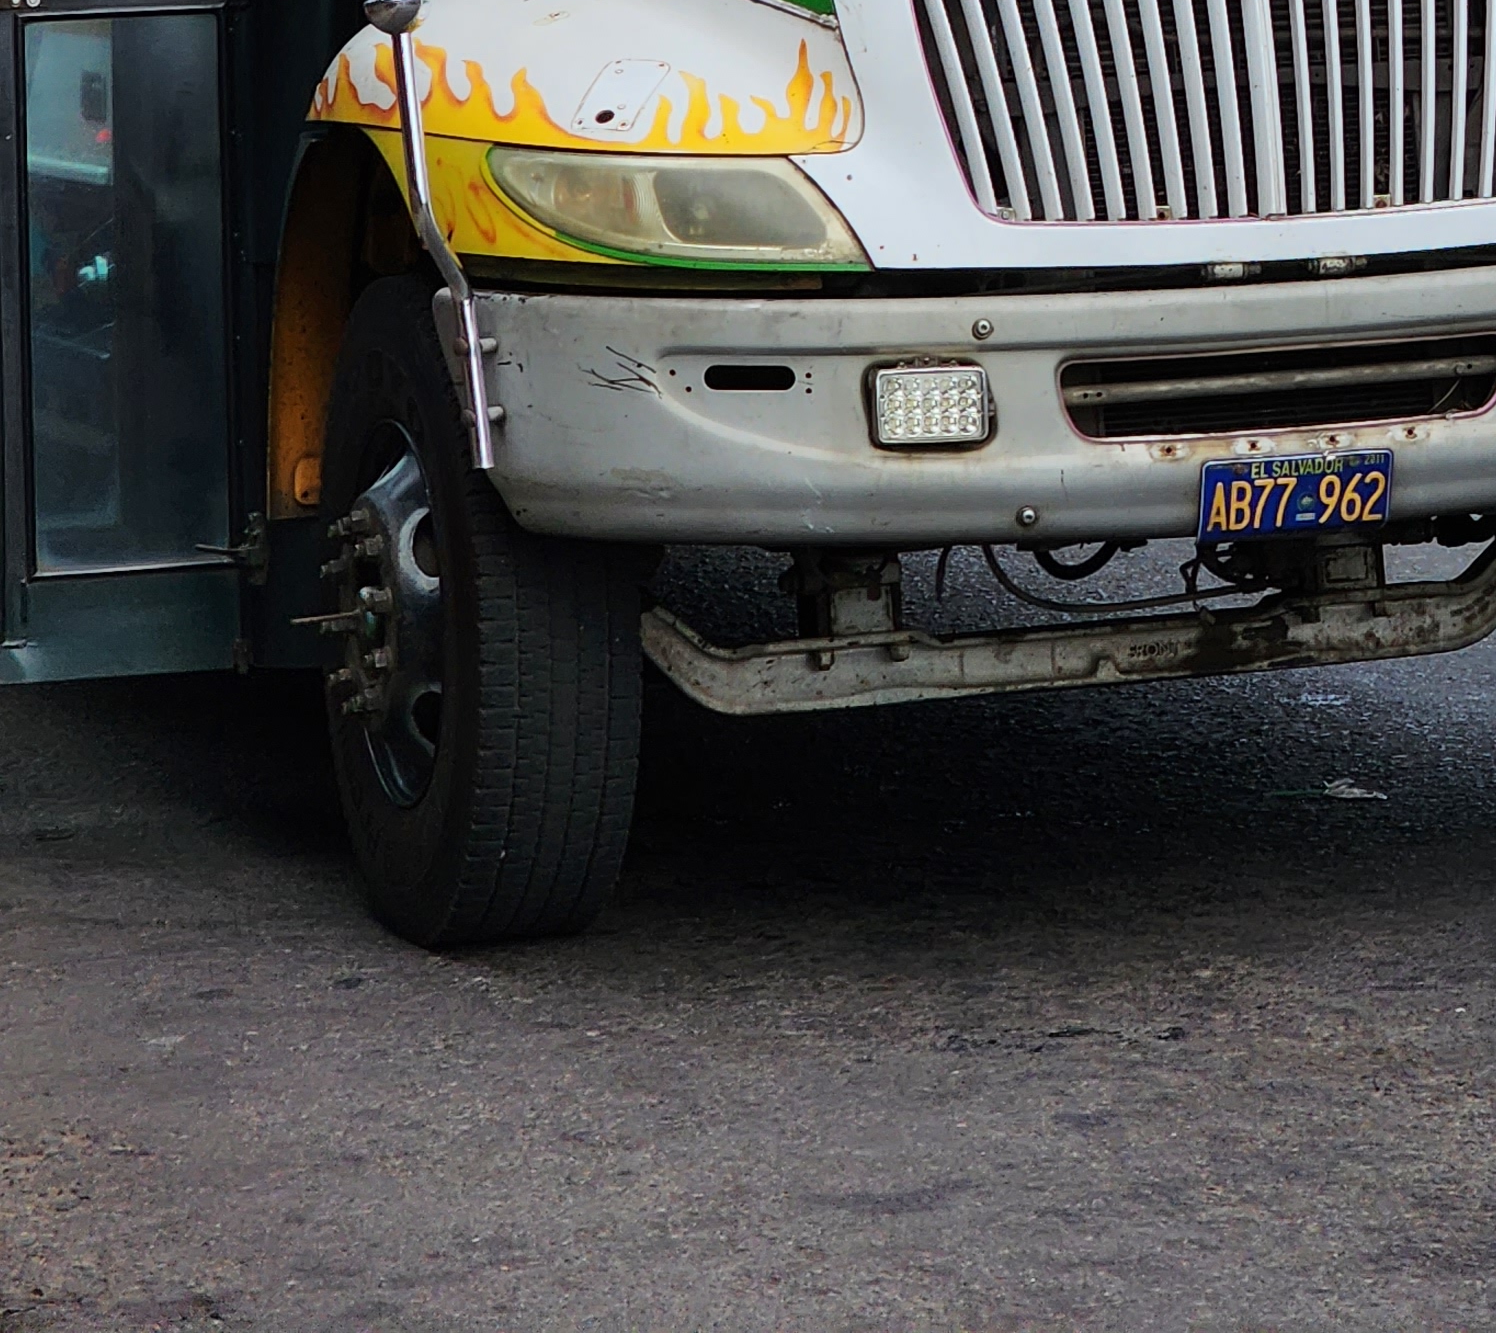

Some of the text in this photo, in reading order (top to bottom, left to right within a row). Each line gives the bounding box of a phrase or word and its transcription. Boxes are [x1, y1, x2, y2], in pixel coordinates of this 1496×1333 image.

[1251, 462, 1268, 479] EL
[1272, 457, 1344, 477] SALVADOR
[1206, 471, 1386, 532] AB77 962
